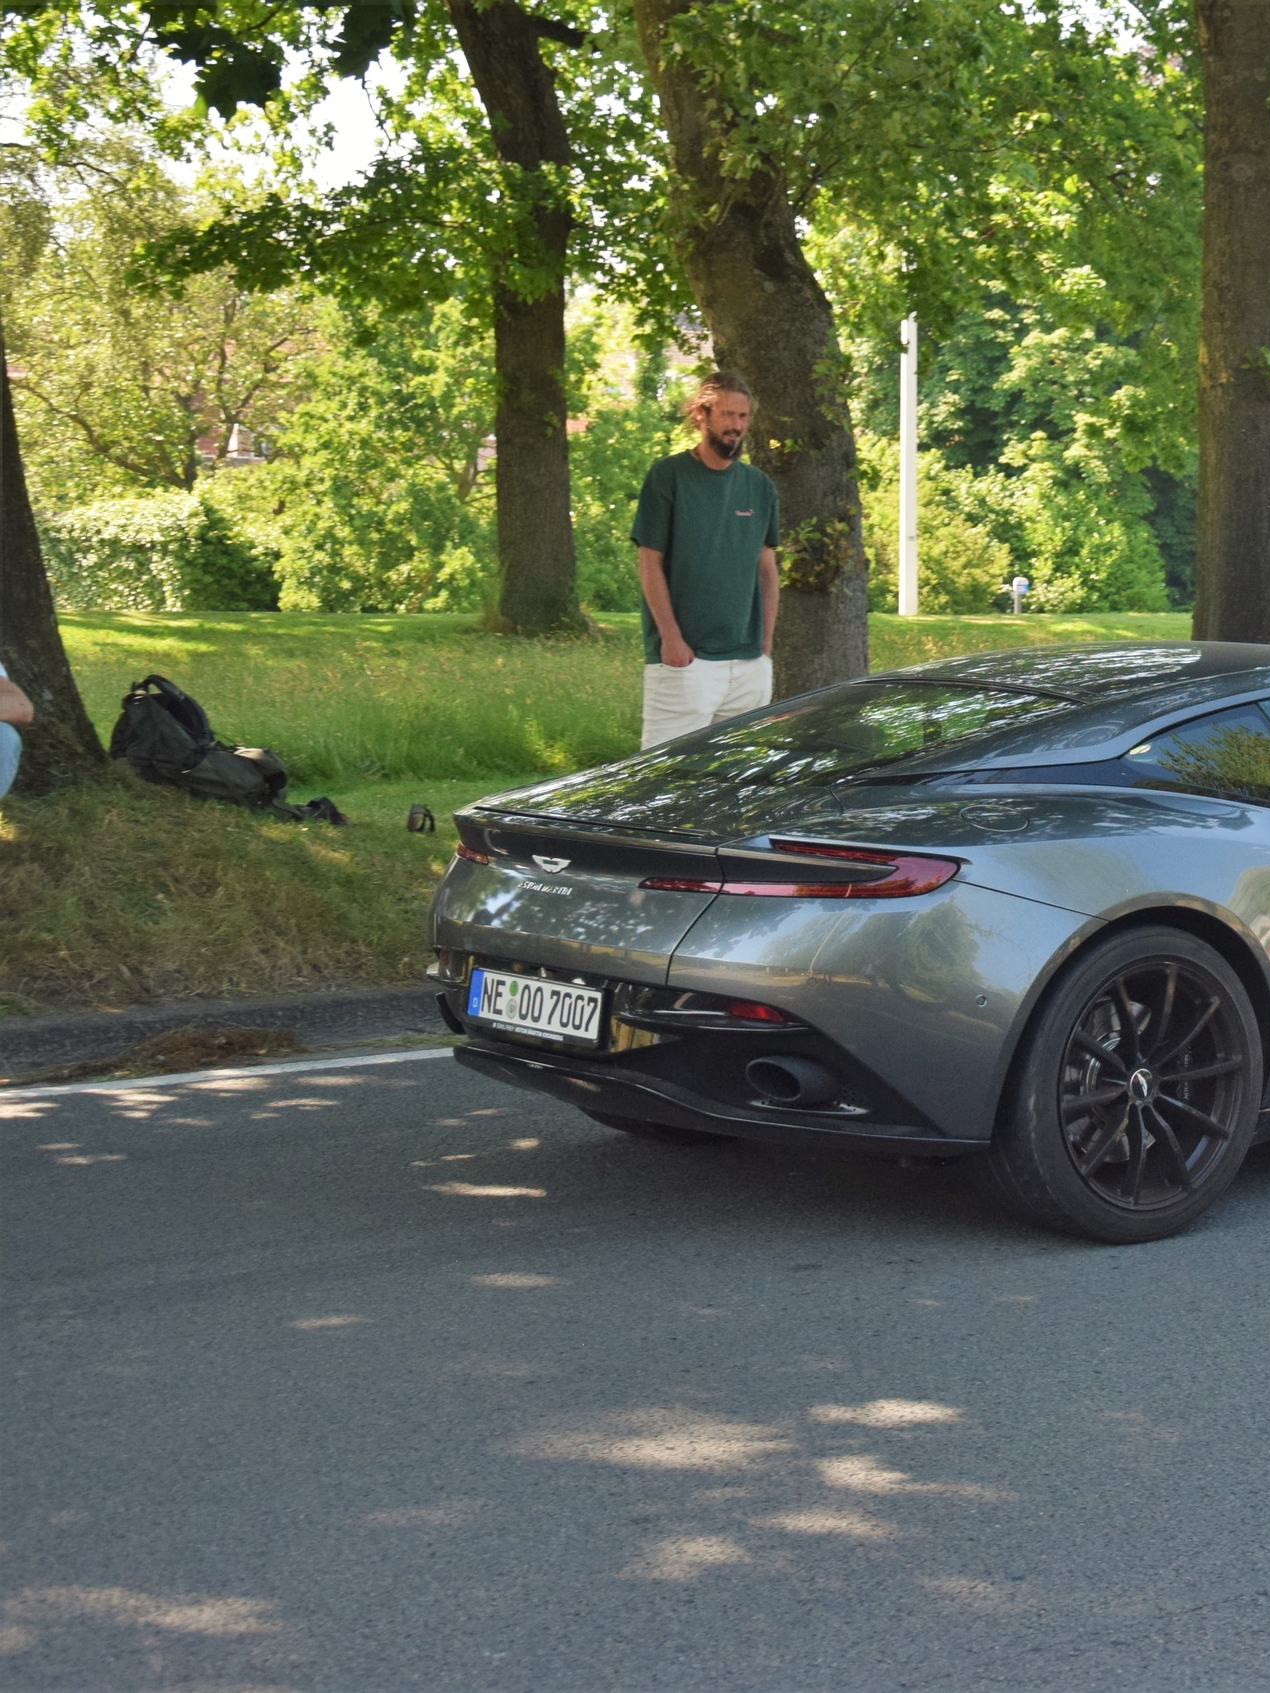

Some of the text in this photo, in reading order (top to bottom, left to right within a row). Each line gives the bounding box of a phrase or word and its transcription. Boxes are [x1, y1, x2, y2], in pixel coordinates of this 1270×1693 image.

[517, 881, 572, 896] ASTON MARTIN
[481, 976, 506, 1016] NE
[547, 989, 599, 1032] 7007
